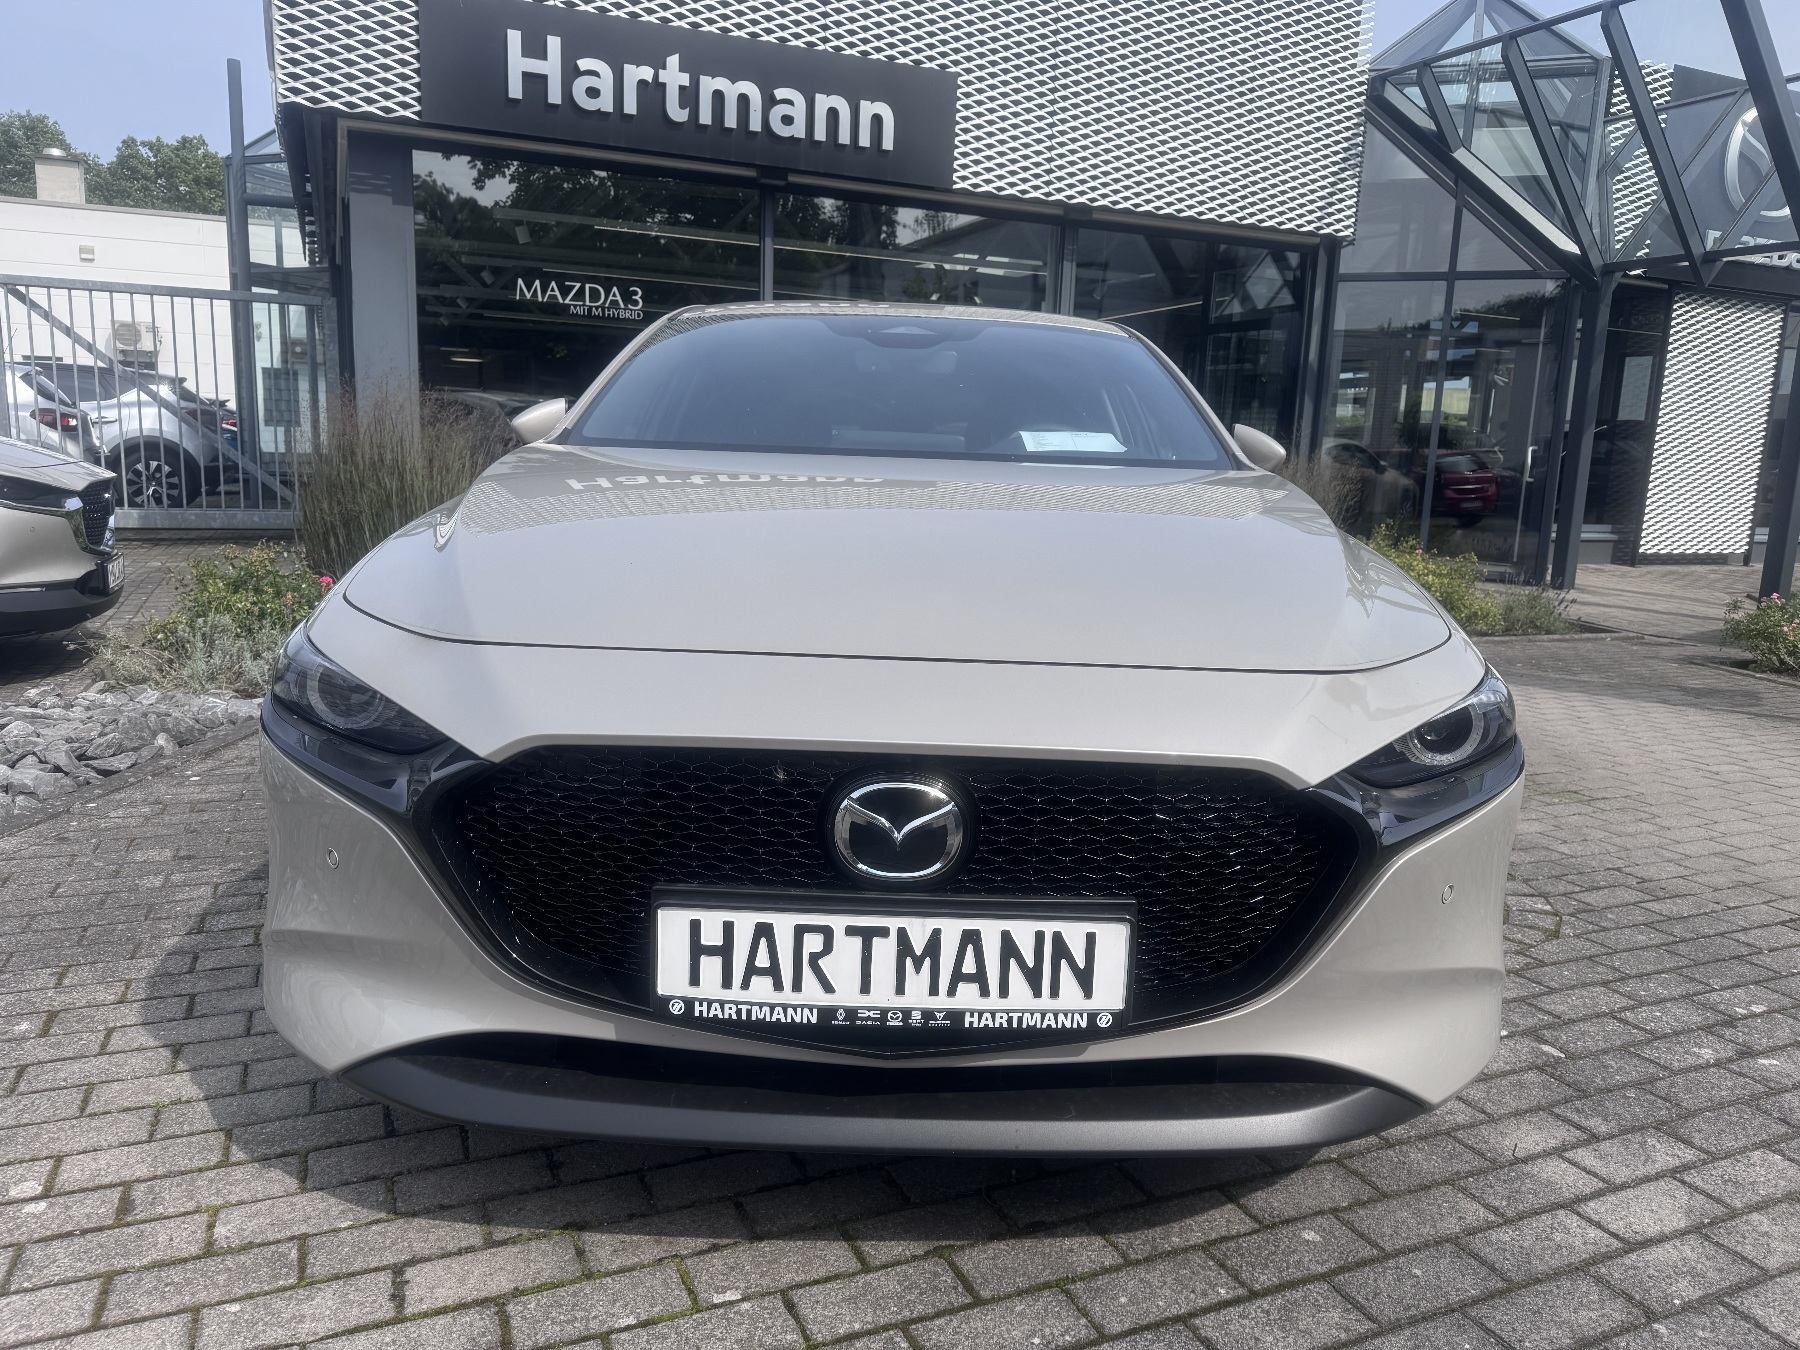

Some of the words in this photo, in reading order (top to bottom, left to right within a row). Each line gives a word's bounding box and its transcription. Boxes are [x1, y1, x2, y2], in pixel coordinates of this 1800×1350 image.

[506, 28, 895, 151] Hartmann
[569, 305, 590, 315] MIT
[591, 307, 602, 317] M
[605, 308, 643, 320] HYBRID
[688, 917, 1097, 1000] HARTMANN
[694, 1001, 818, 1024] HARTMANN
[964, 1011, 1088, 1029] HARTMANN
